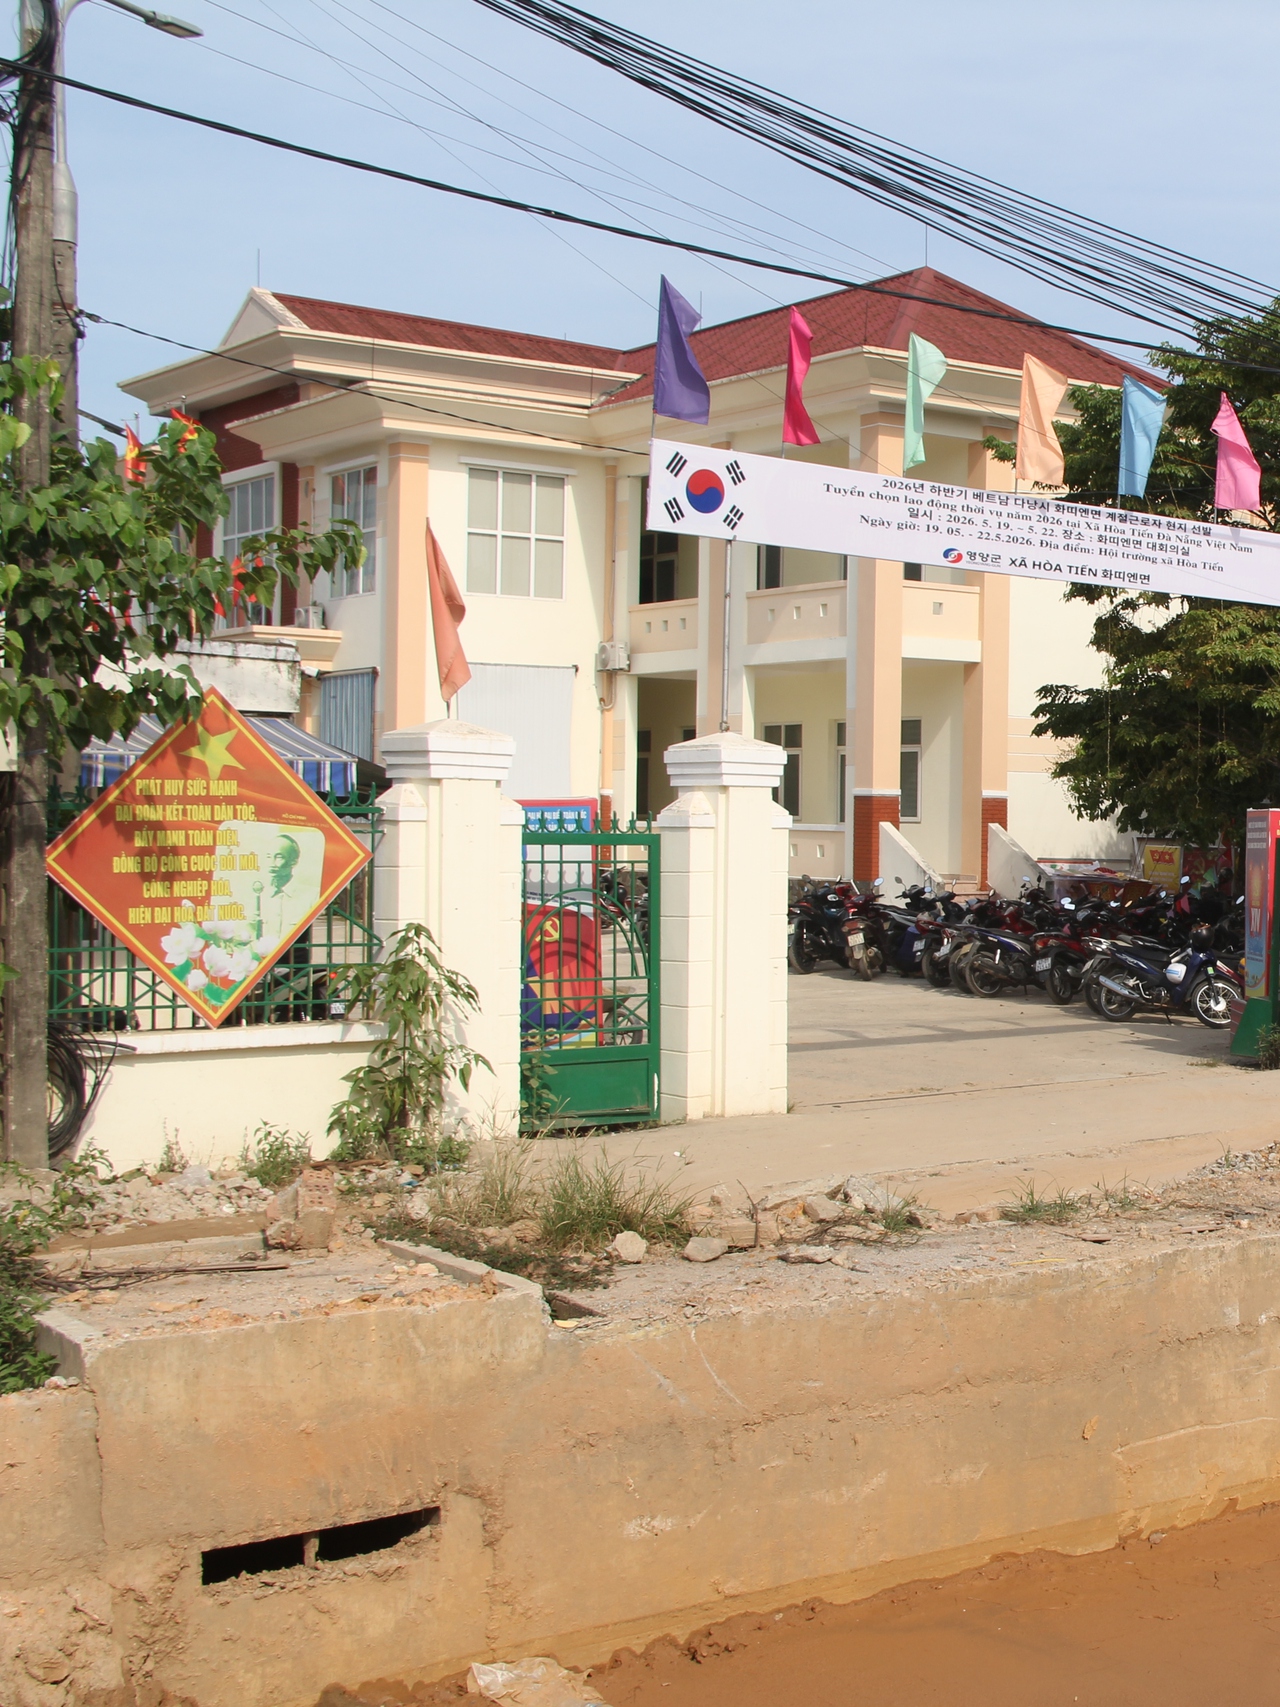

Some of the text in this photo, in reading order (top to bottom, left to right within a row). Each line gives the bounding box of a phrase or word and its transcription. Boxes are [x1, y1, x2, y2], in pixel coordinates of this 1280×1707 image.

[823, 482, 1253, 554] Tuyển chọn lao động thời vụ năm 2026 tại Xã Hòa Tiến Đà Nẵng Việt Nam
[882, 479, 925, 494] 2026년
[929, 484, 968, 500] 하반기
[972, 491, 1009, 506] 베트남
[1014, 497, 1050, 512] 다낭시
[1105, 511, 1163, 528] 계절근로자
[1166, 520, 1187, 533] 현지
[1190, 524, 1213, 537] 선발
[859, 514, 1224, 573] Ngày giờ: 19. 05. 22.5.2026. Địa điểm: Hội trường xã Hòa Tiến
[907, 507, 1190, 557] 일시 2026. 5. 19. 5. 22. 장소 화띠엔면 대회의실
[966, 551, 1002, 564] 영양군
[1008, 556, 1098, 578] XÃ HÒA TIẾN
[1101, 568, 1151, 586] 화띠엔면
[136, 777, 238, 799] PHÁT HUY SỨC MẠNH
[115, 804, 133, 825] ĐẠI
[135, 802, 163, 821] ĐOÀN
[165, 799, 184, 821] KẾT
[186, 802, 212, 821] TOÀN
[214, 802, 234, 821] DÂN
[236, 802, 258, 825] TỘC,
[134, 825, 240, 850] ĐẨY MẠNH TOÀN DIỆN,
[112, 848, 260, 875] ĐỒNG BỘ CÔNG CUỘC ĐỔI MỚI,
[143, 877, 232, 900] CÔNG NGHIỆP HÓA,
[128, 900, 247, 927] HIỆN ĐẠI HÓA ĐẤT NƯỚC.
